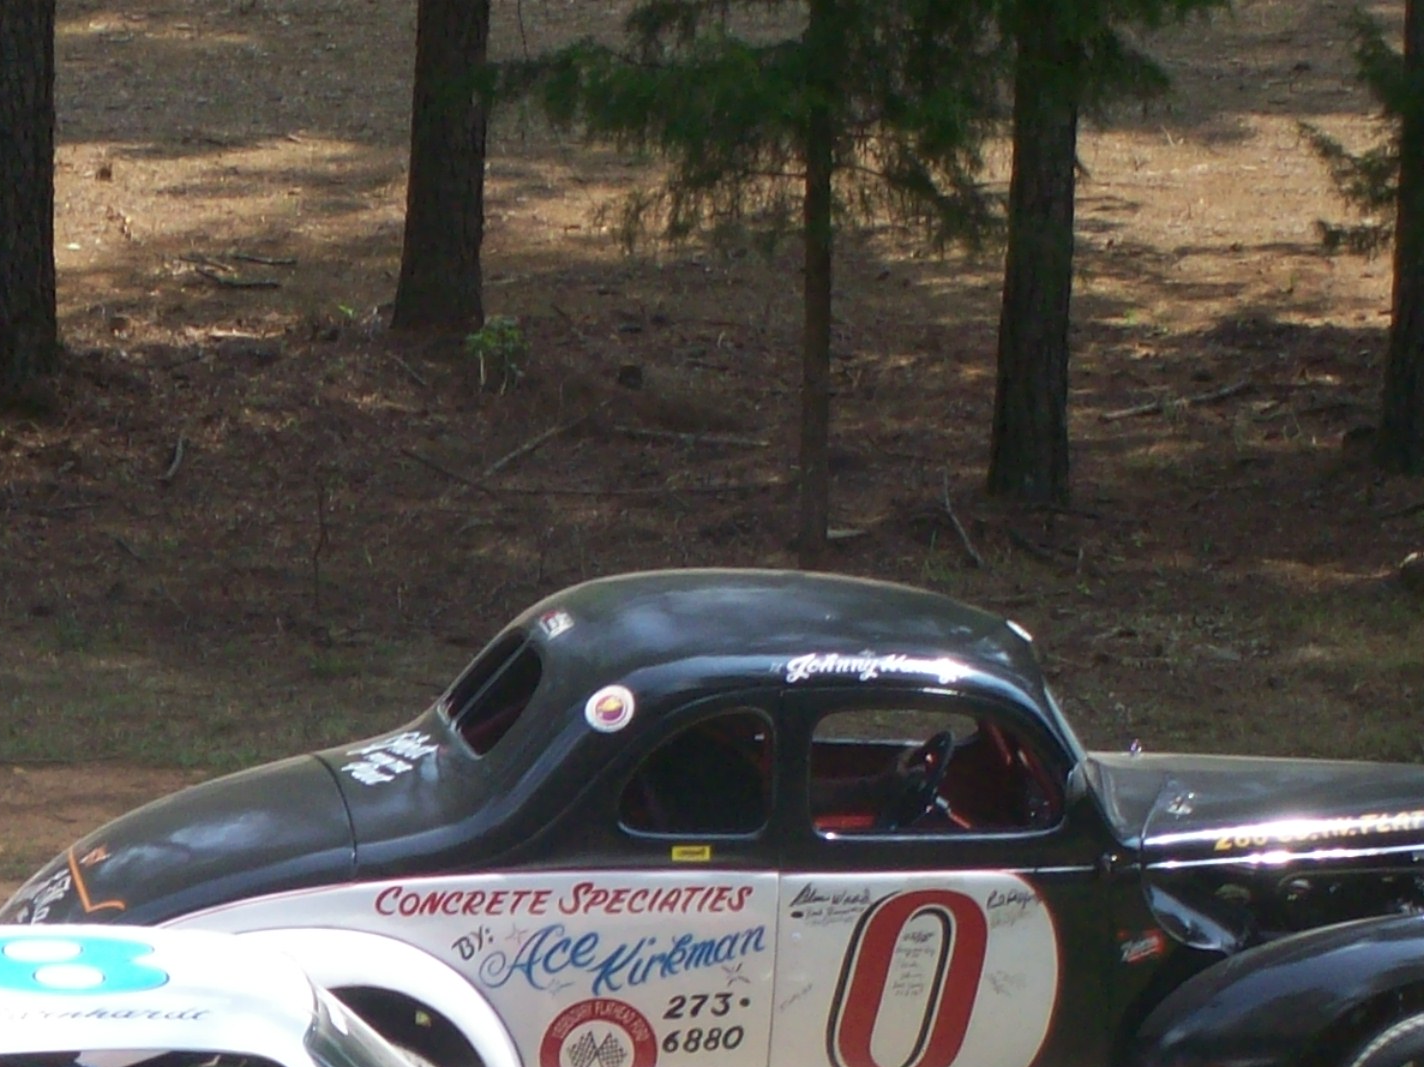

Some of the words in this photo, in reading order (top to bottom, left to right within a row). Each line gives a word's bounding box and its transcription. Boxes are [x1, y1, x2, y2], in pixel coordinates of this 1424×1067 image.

[374, 886, 552, 917] CONCRETE
[452, 926, 493, 962] BY:
[479, 923, 599, 990] Ace
[586, 925, 767, 996] Kirkman
[662, 1025, 745, 1054] 6880
